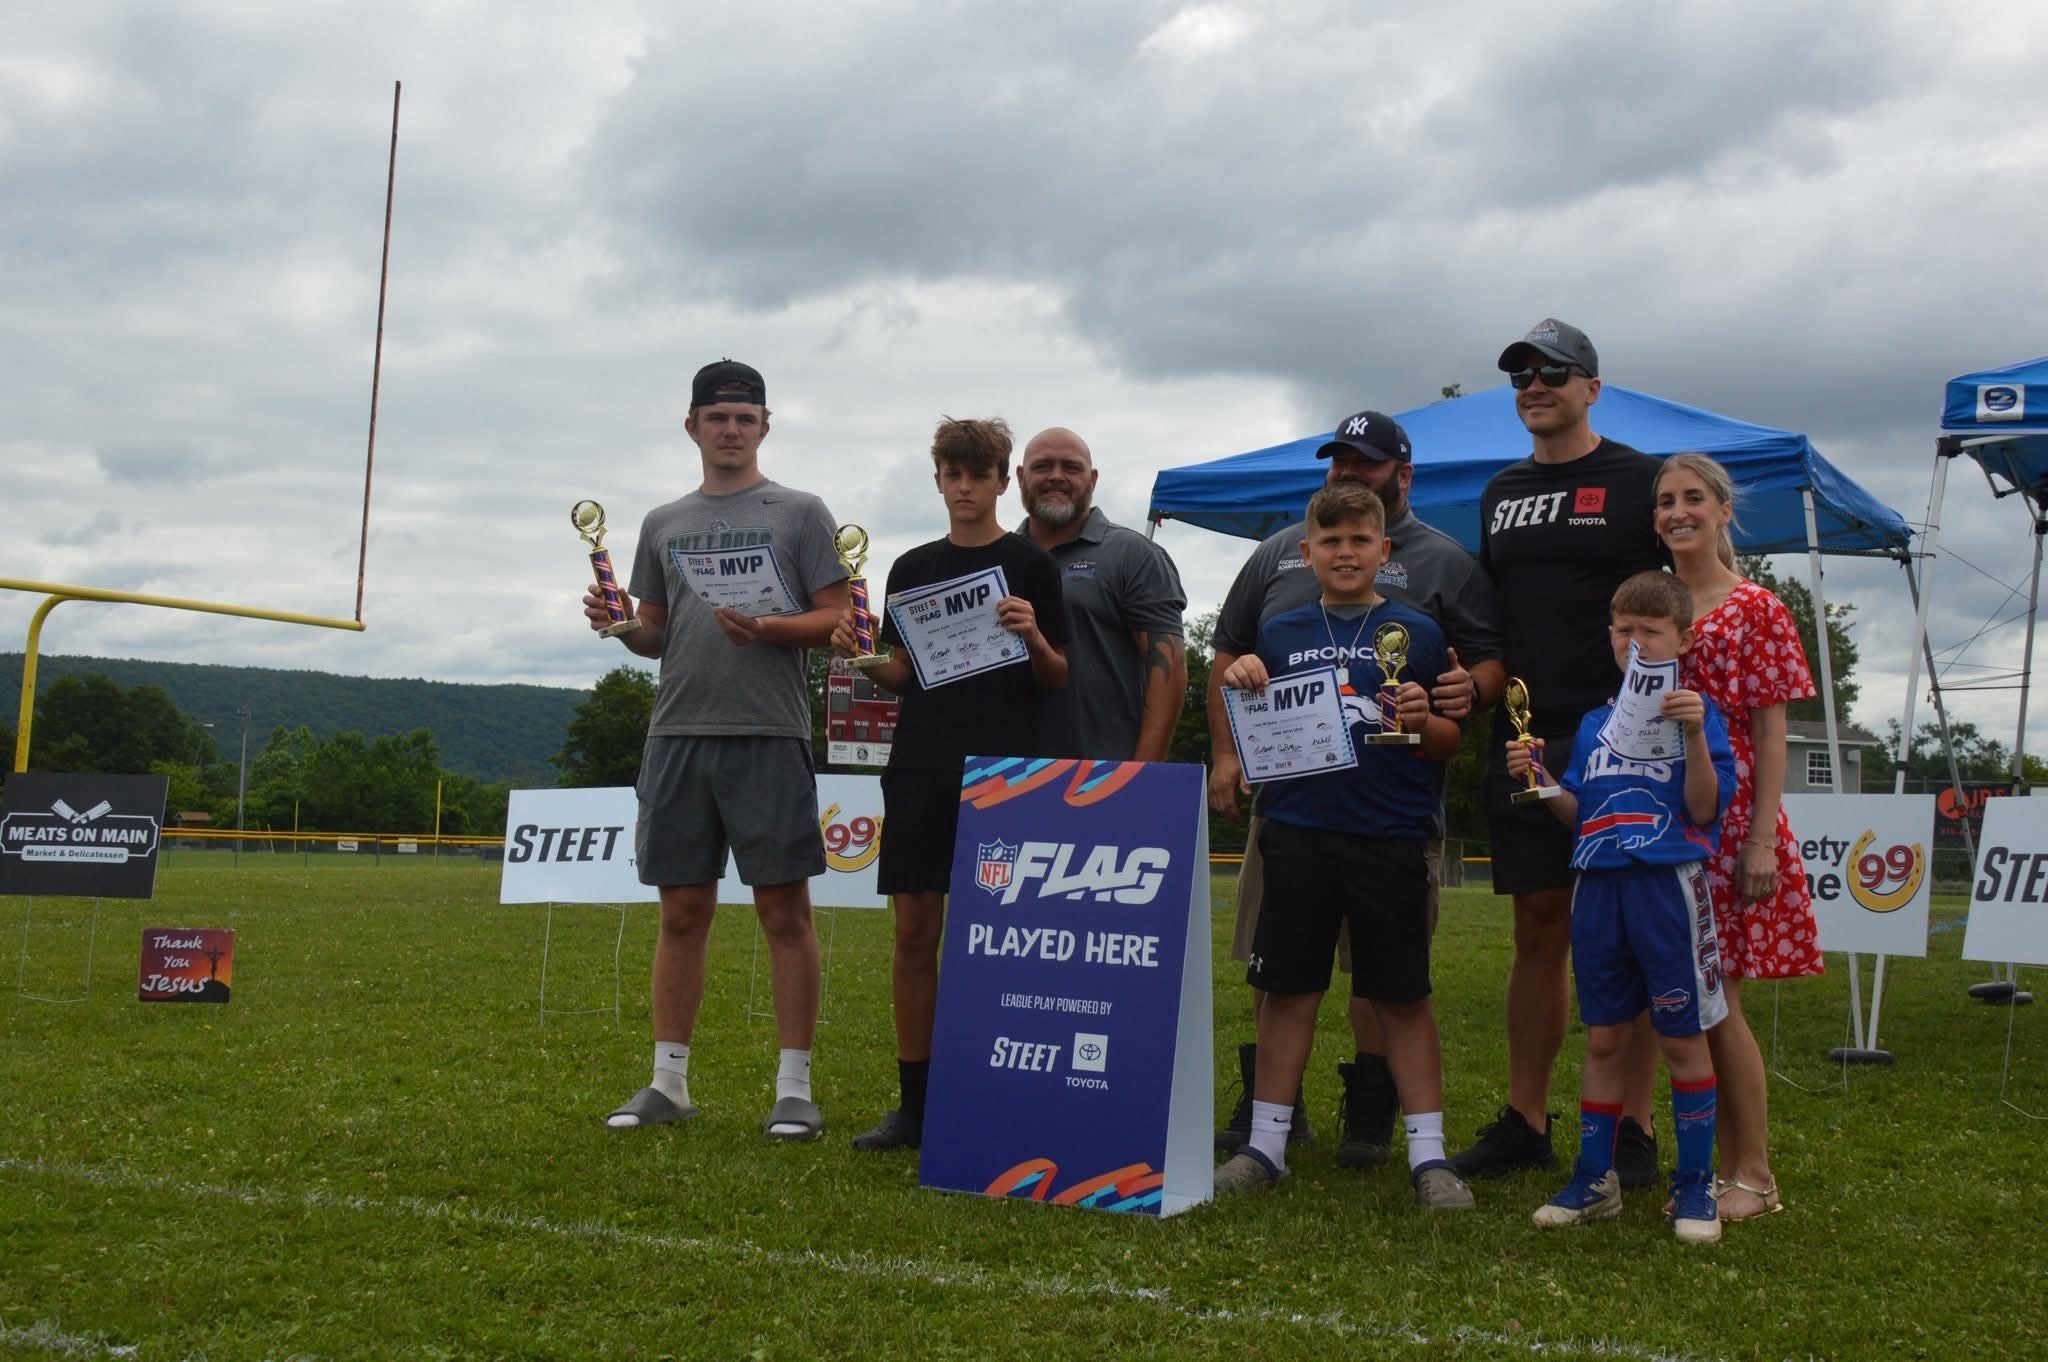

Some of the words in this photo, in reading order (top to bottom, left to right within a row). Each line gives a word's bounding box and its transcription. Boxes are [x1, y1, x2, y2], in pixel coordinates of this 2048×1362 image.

[1490, 491, 1568, 536] STEET
[1568, 517, 1607, 526] TOYOTA
[719, 555, 763, 577] MVP
[944, 583, 990, 617] MVP
[829, 685, 851, 695] HOME
[1273, 681, 1325, 712] MVP
[8, 826, 68, 842] MEATS
[72, 827, 97, 843] ON
[101, 828, 148, 845] MAIN
[508, 823, 625, 864] STEET
[826, 816, 877, 853] 99
[1795, 834, 1850, 867] ety
[26, 849, 57, 858] Market
[59, 850, 66, 858] &
[68, 850, 125, 860] Delicatessen
[1857, 844, 1915, 890] 99
[979, 861, 1010, 888] NFL
[1001, 841, 1171, 905] FLAG
[153, 935, 204, 950] Thank
[967, 924, 1074, 962] PLAYED
[1085, 931, 1160, 968] HERE
[163, 955, 190, 969] You
[141, 973, 209, 993] Jesus
[1001, 993, 1032, 1010] LEAGUE
[1033, 996, 1056, 1012] PLAY
[1056, 997, 1099, 1015] POWERED
[1099, 1001, 1112, 1016] BY
[989, 1036, 1061, 1073] STEET
[1065, 1076, 1109, 1091] TOYOTA
